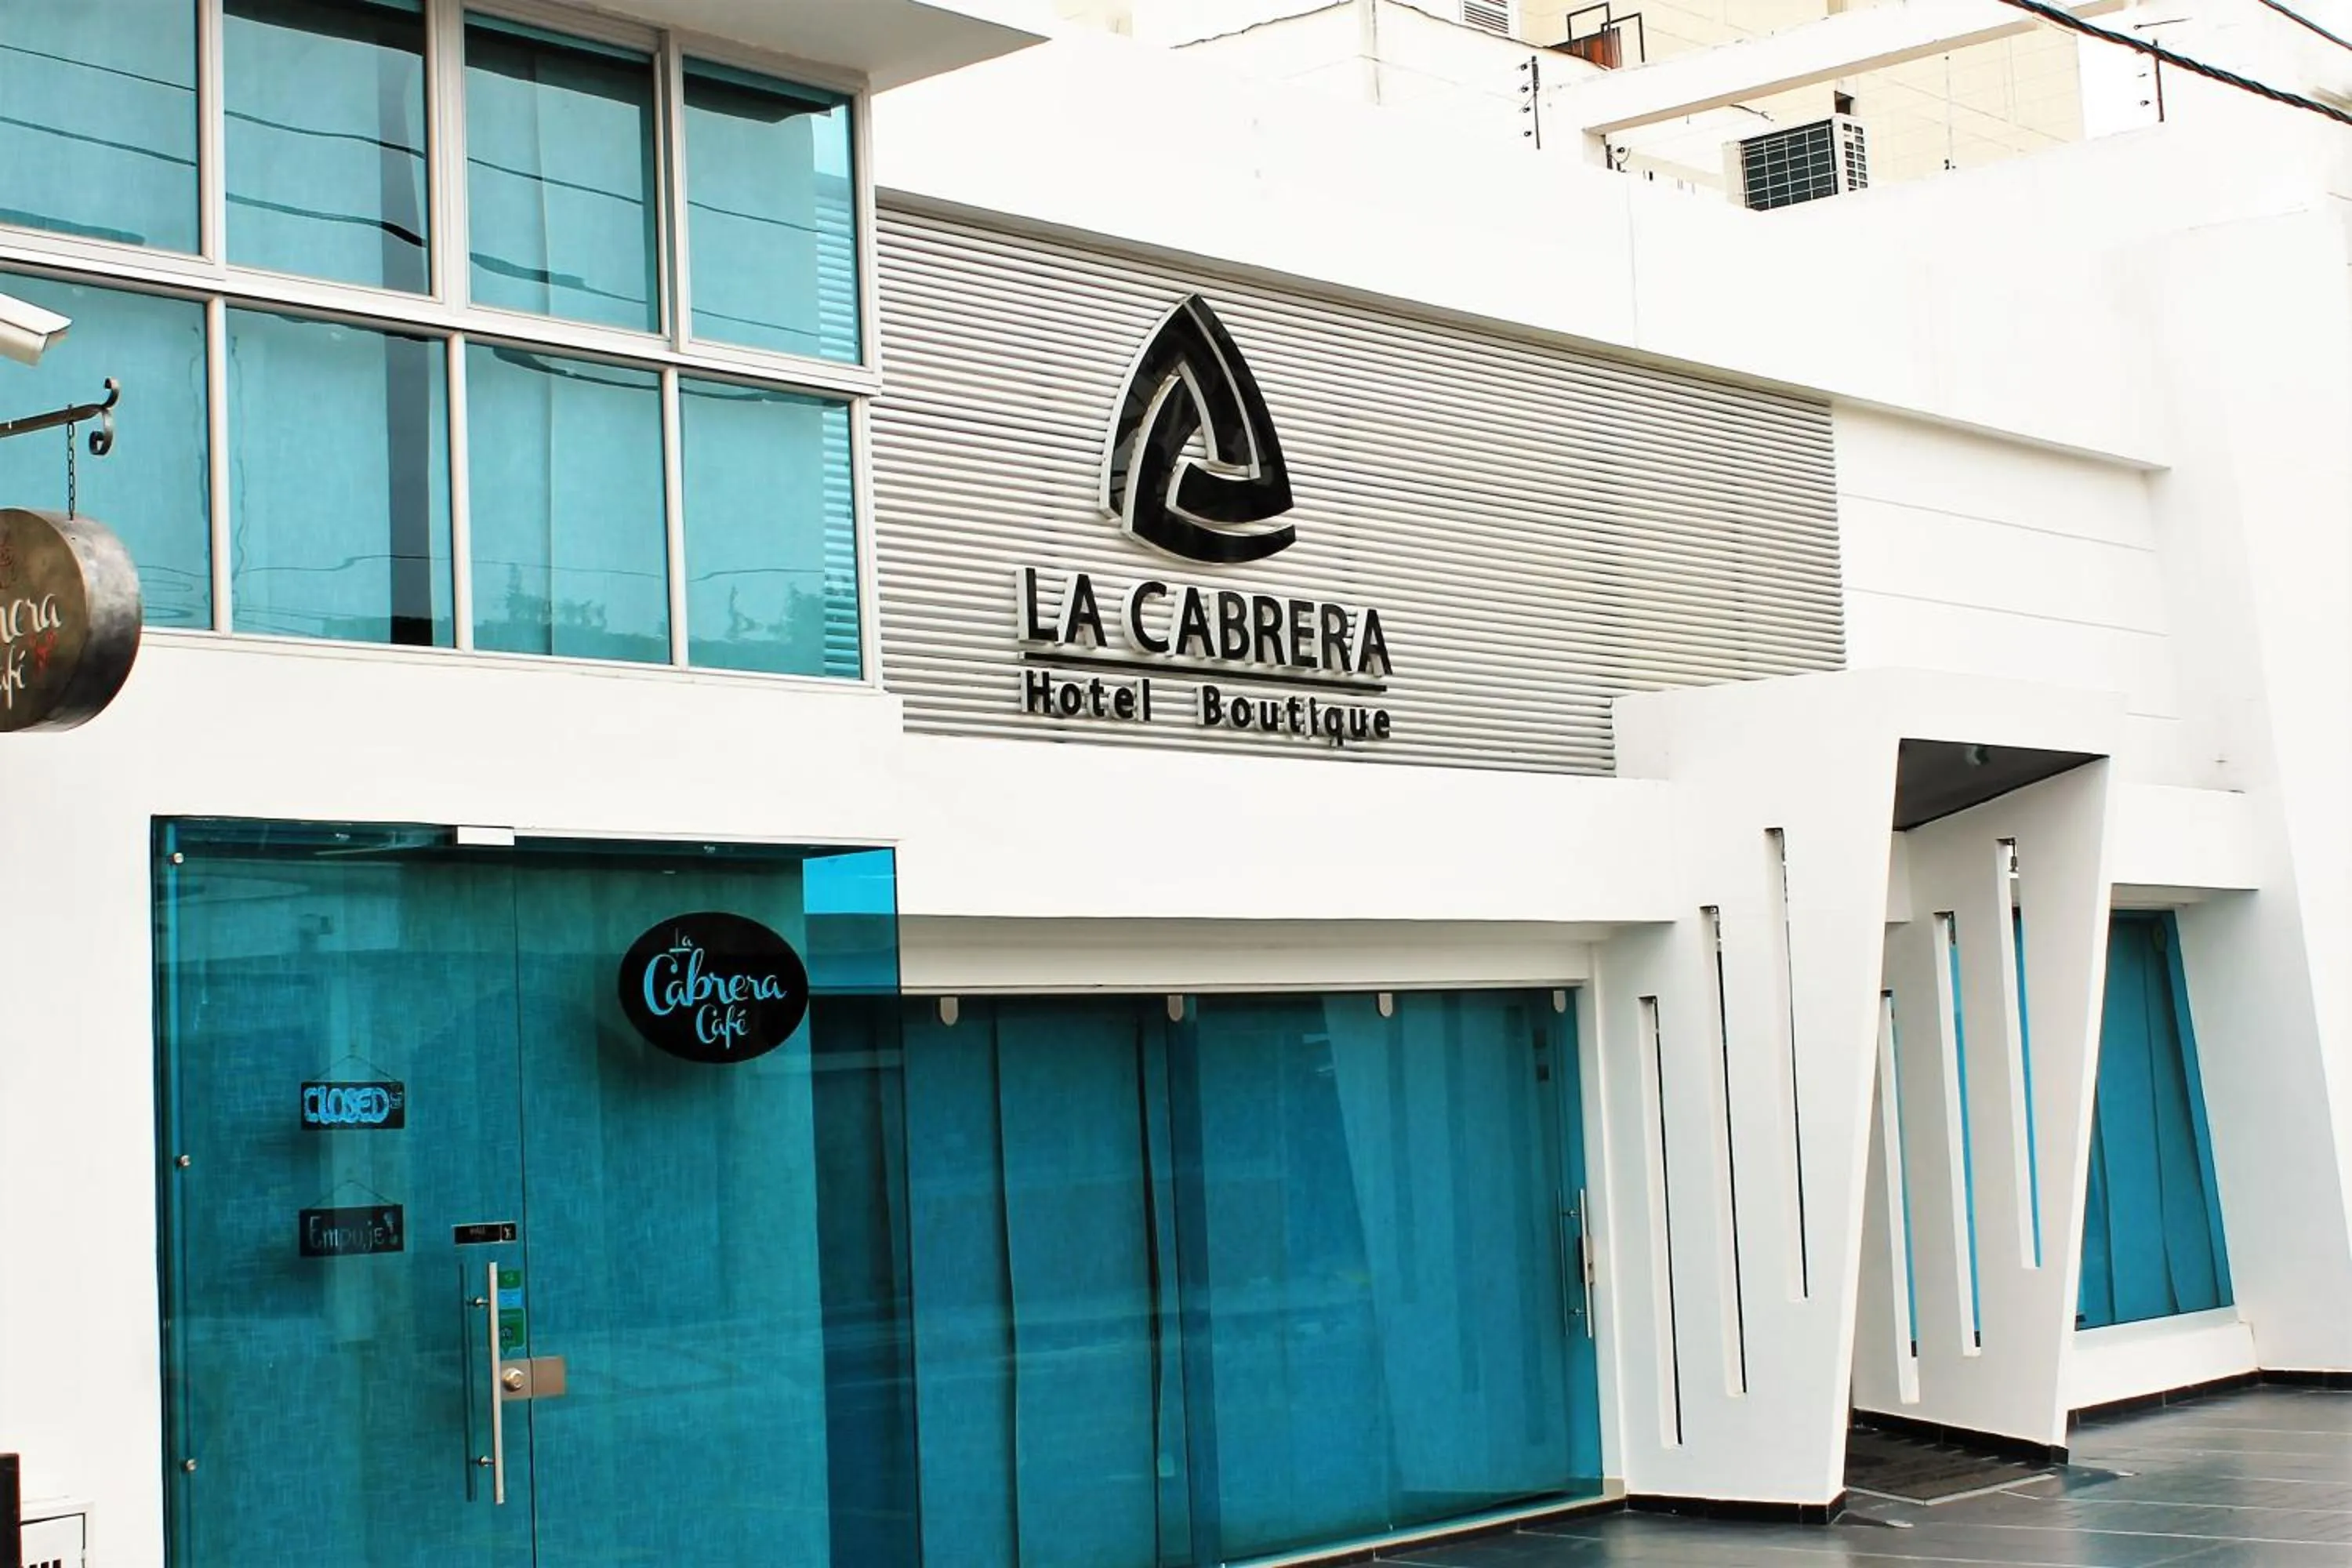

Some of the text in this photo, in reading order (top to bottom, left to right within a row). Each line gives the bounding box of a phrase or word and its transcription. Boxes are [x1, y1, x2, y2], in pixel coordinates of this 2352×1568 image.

[1017, 567, 1393, 676] LA CABRERA
[1022, 670, 1391, 747] Hotel Boutique
[644, 948, 787, 1016] Cabrera
[695, 1004, 750, 1049] Café
